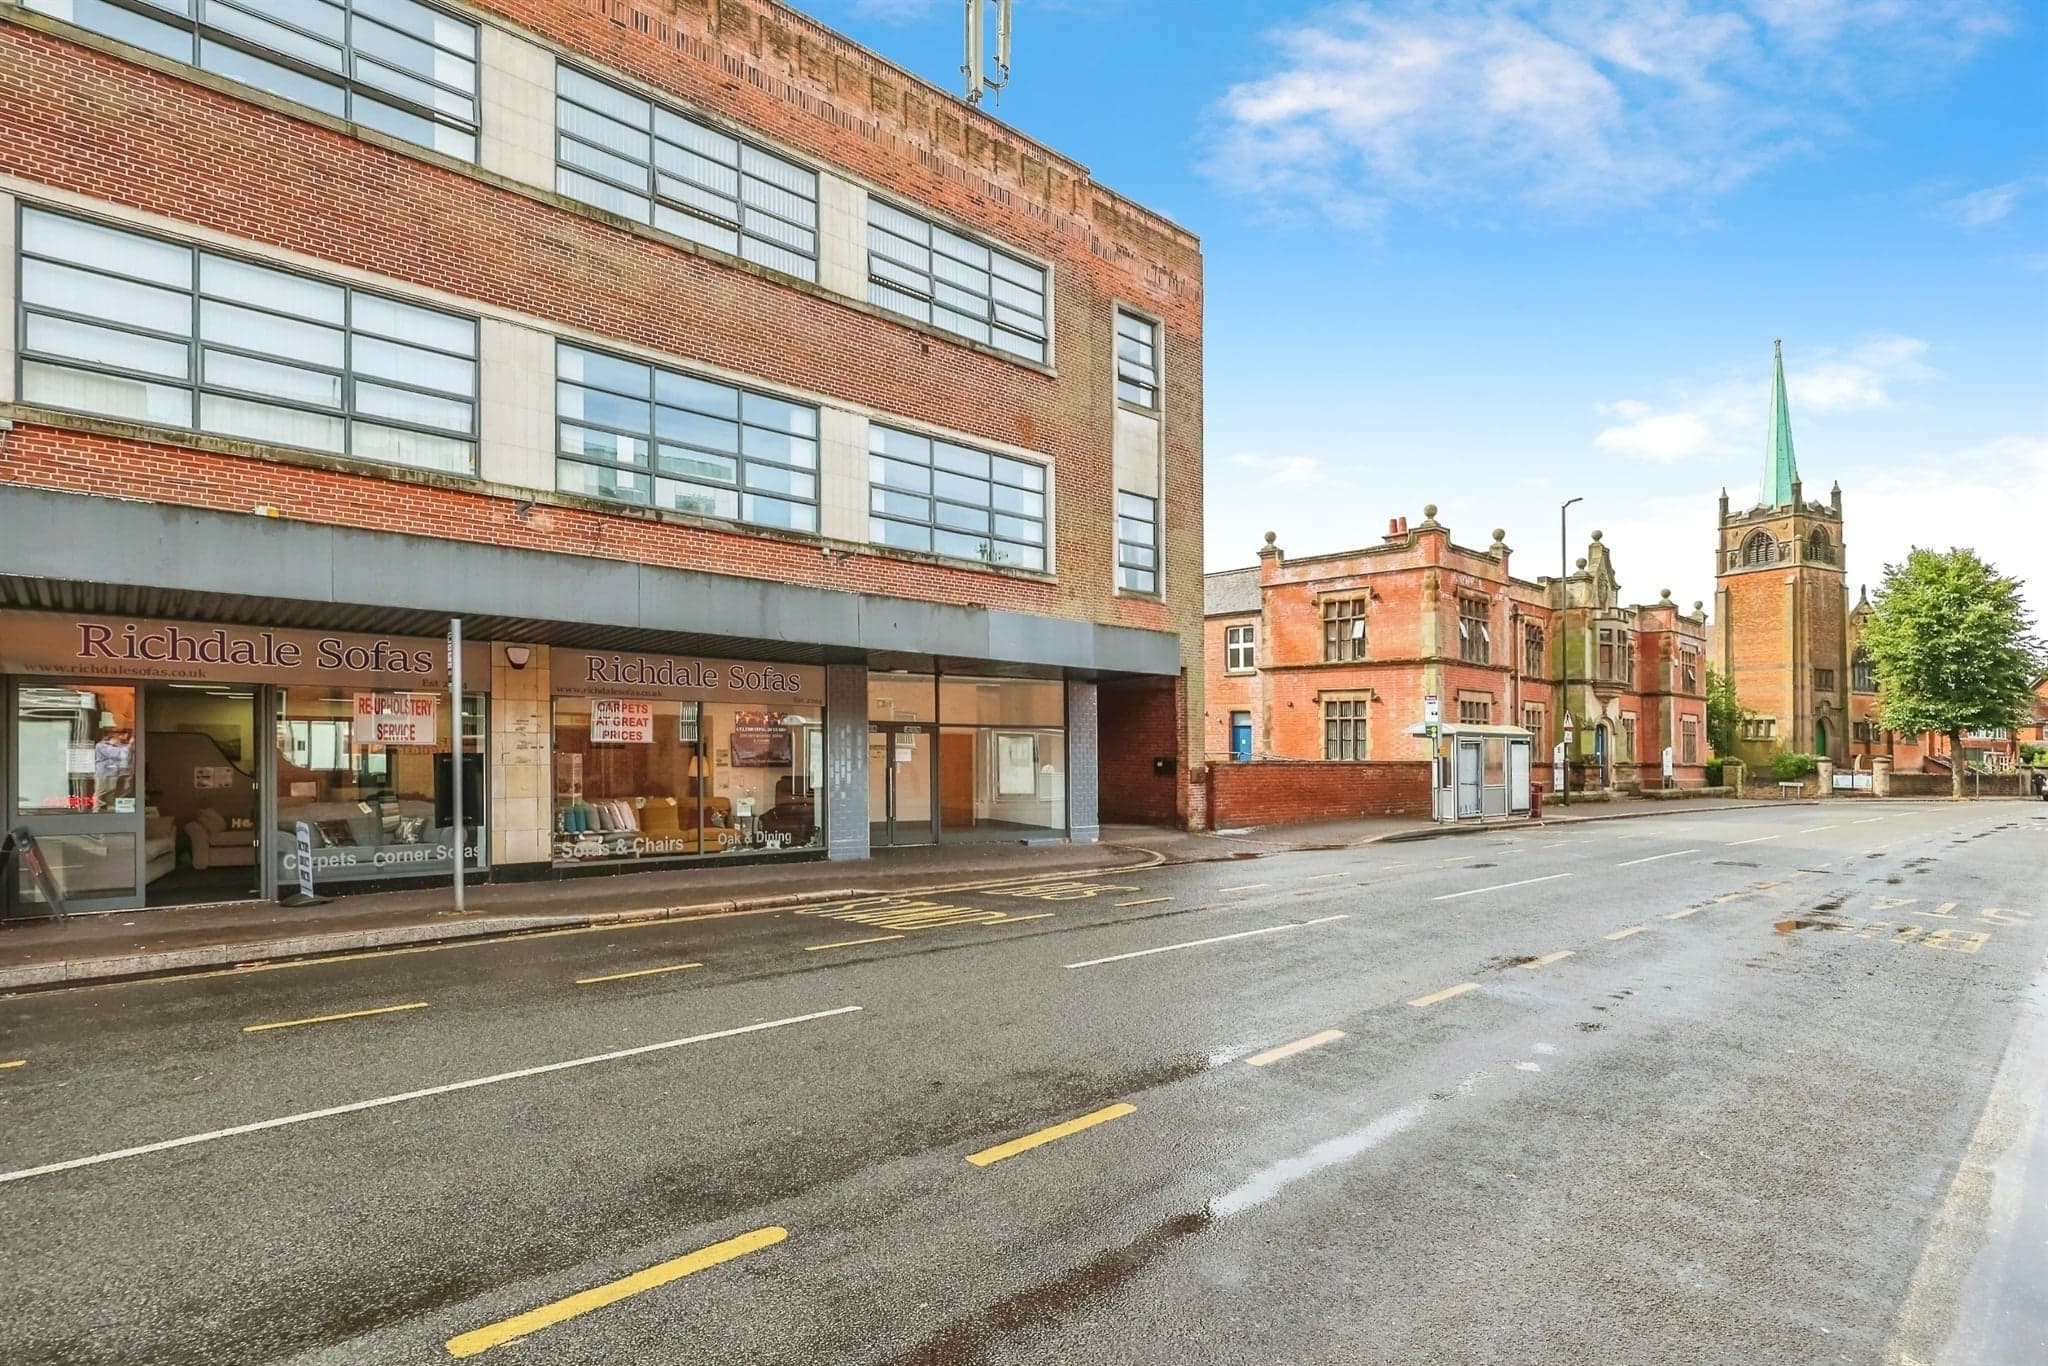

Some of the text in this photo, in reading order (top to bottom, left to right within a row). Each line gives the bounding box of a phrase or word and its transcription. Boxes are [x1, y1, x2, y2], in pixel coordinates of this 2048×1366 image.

[76, 622, 433, 674] Richdale Sofas
[24, 661, 207, 679] www.richdalesofas.co.uk
[585, 655, 801, 694] Richdale Sofas
[597, 702, 649, 714] CARPETS
[596, 716, 649, 727] AT GREAT
[377, 723, 415, 741] SERVICE
[602, 730, 643, 741] PRICES
[615, 838, 628, 855] &
[633, 836, 684, 855] Chairs
[718, 830, 792, 845] Oak & Dining
[283, 852, 357, 872] Crpets
[373, 848, 431, 867] Corner
[436, 844, 481, 861] Soas
